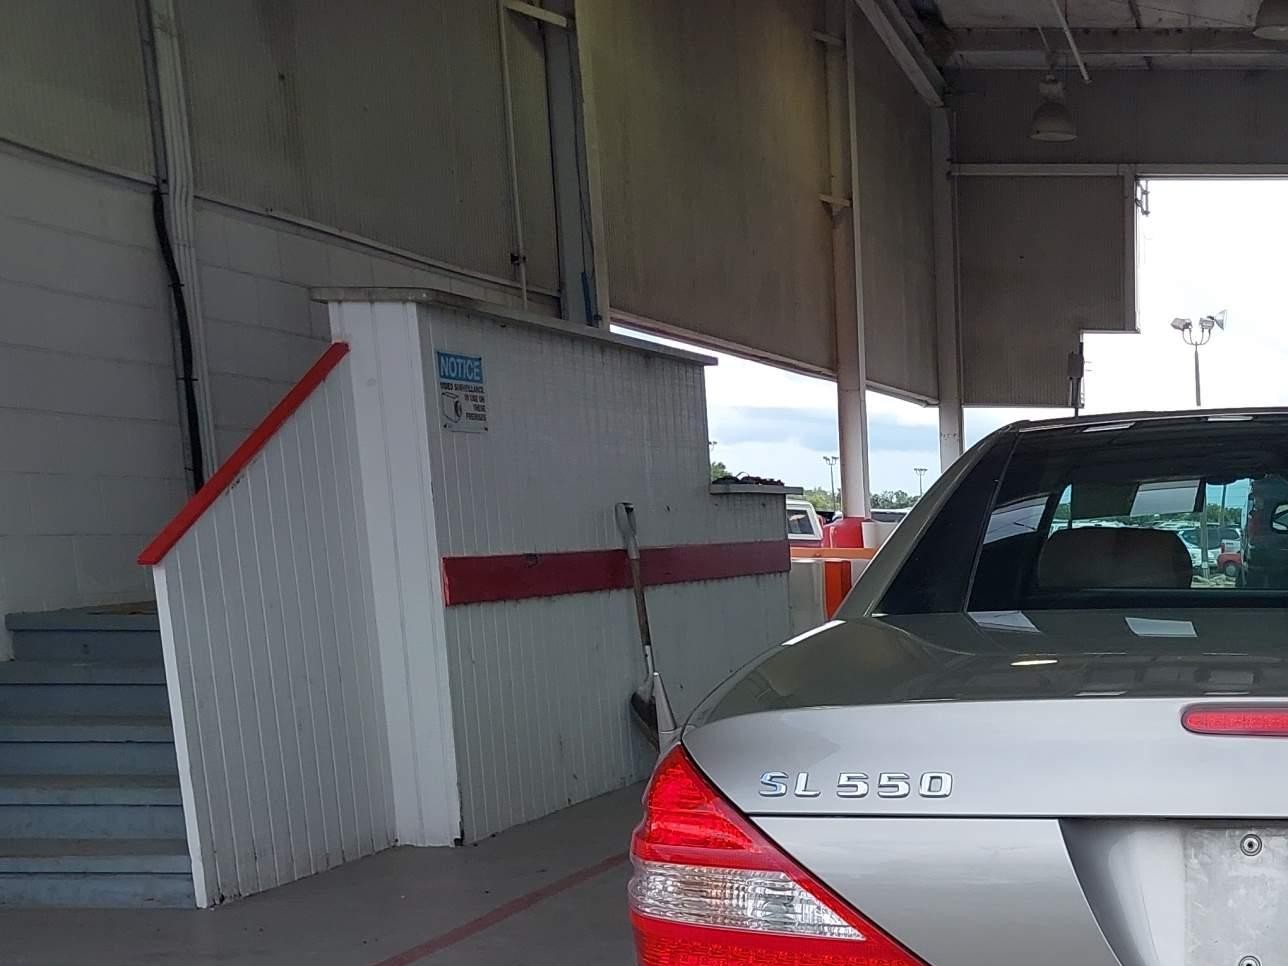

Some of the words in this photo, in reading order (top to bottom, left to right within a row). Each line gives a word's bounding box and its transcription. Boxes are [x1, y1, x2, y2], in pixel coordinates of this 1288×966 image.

[440, 356, 481, 380] NOTICE
[759, 771, 821, 798] SL
[836, 771, 953, 798] 550
